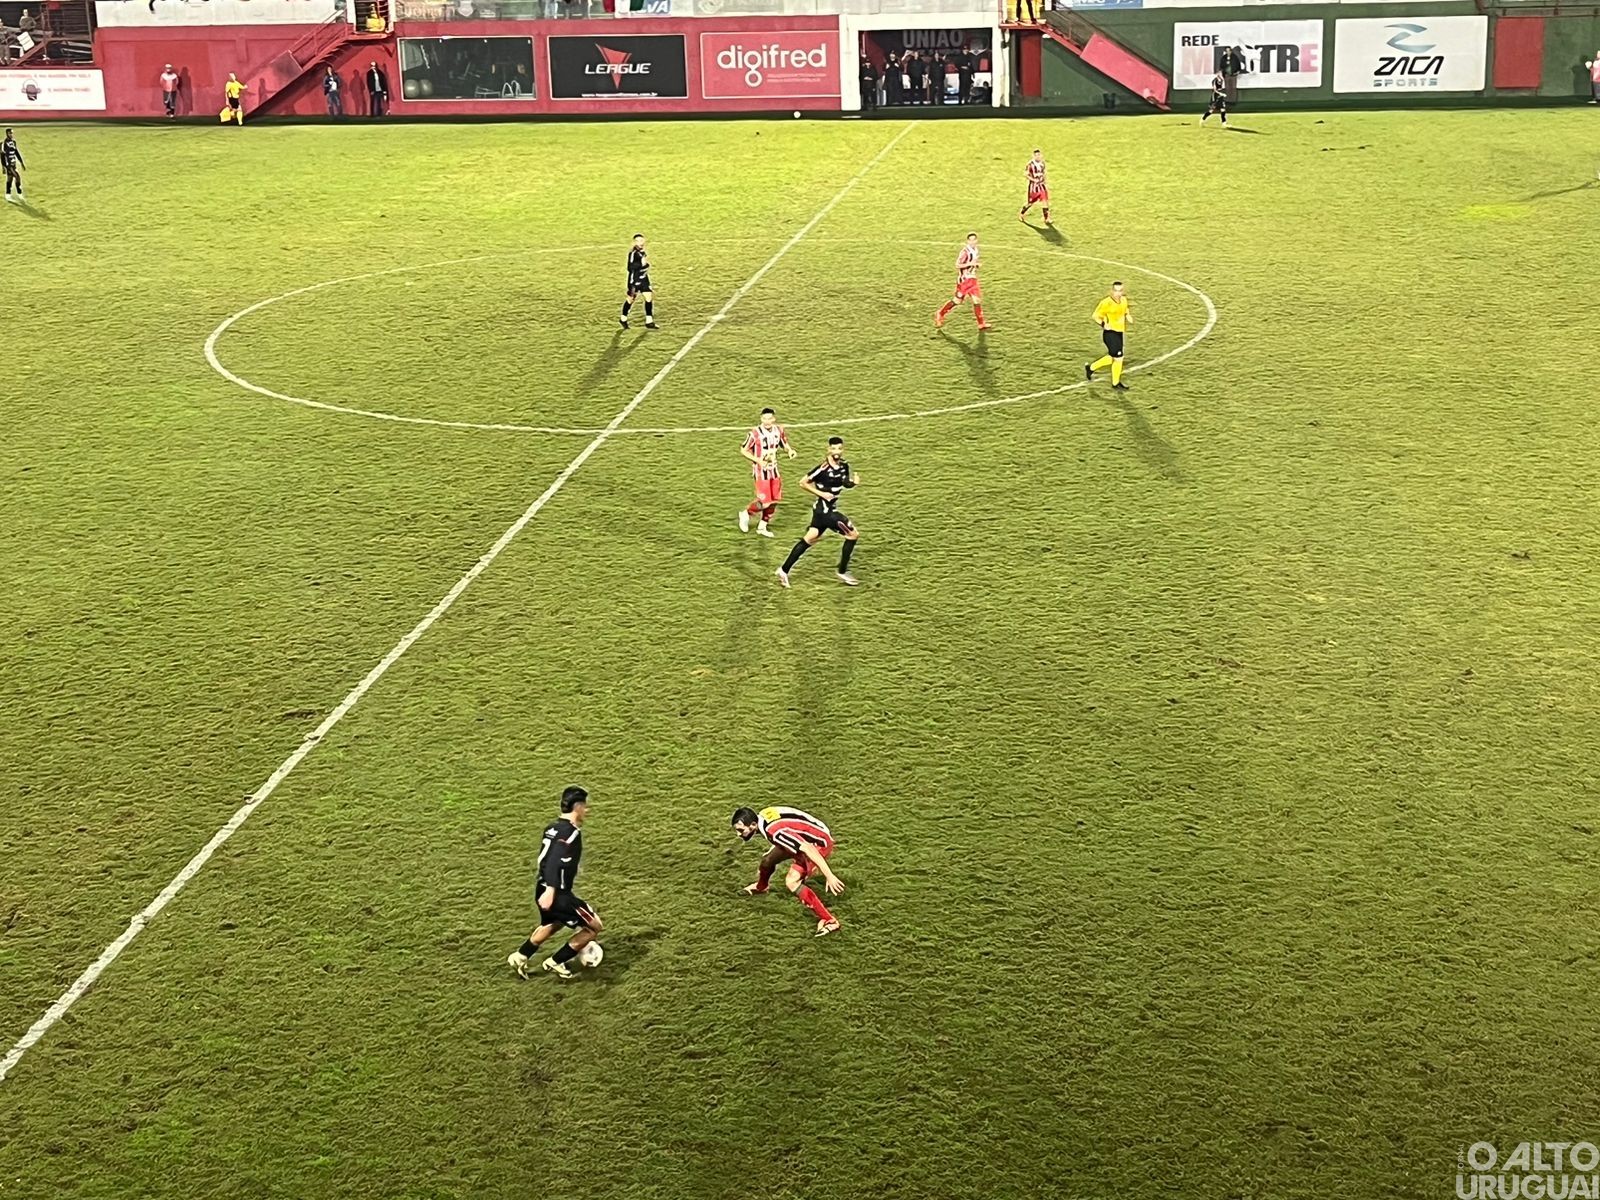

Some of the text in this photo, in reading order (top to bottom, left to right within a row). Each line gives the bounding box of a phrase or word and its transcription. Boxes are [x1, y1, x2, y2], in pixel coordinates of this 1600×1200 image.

[1181, 35, 1219, 47] REDE
[584, 63, 651, 75] LEAGUE
[717, 43, 827, 87] digifred
[1373, 55, 1444, 76] ZACA
[1373, 78, 1438, 88] SPORTS
